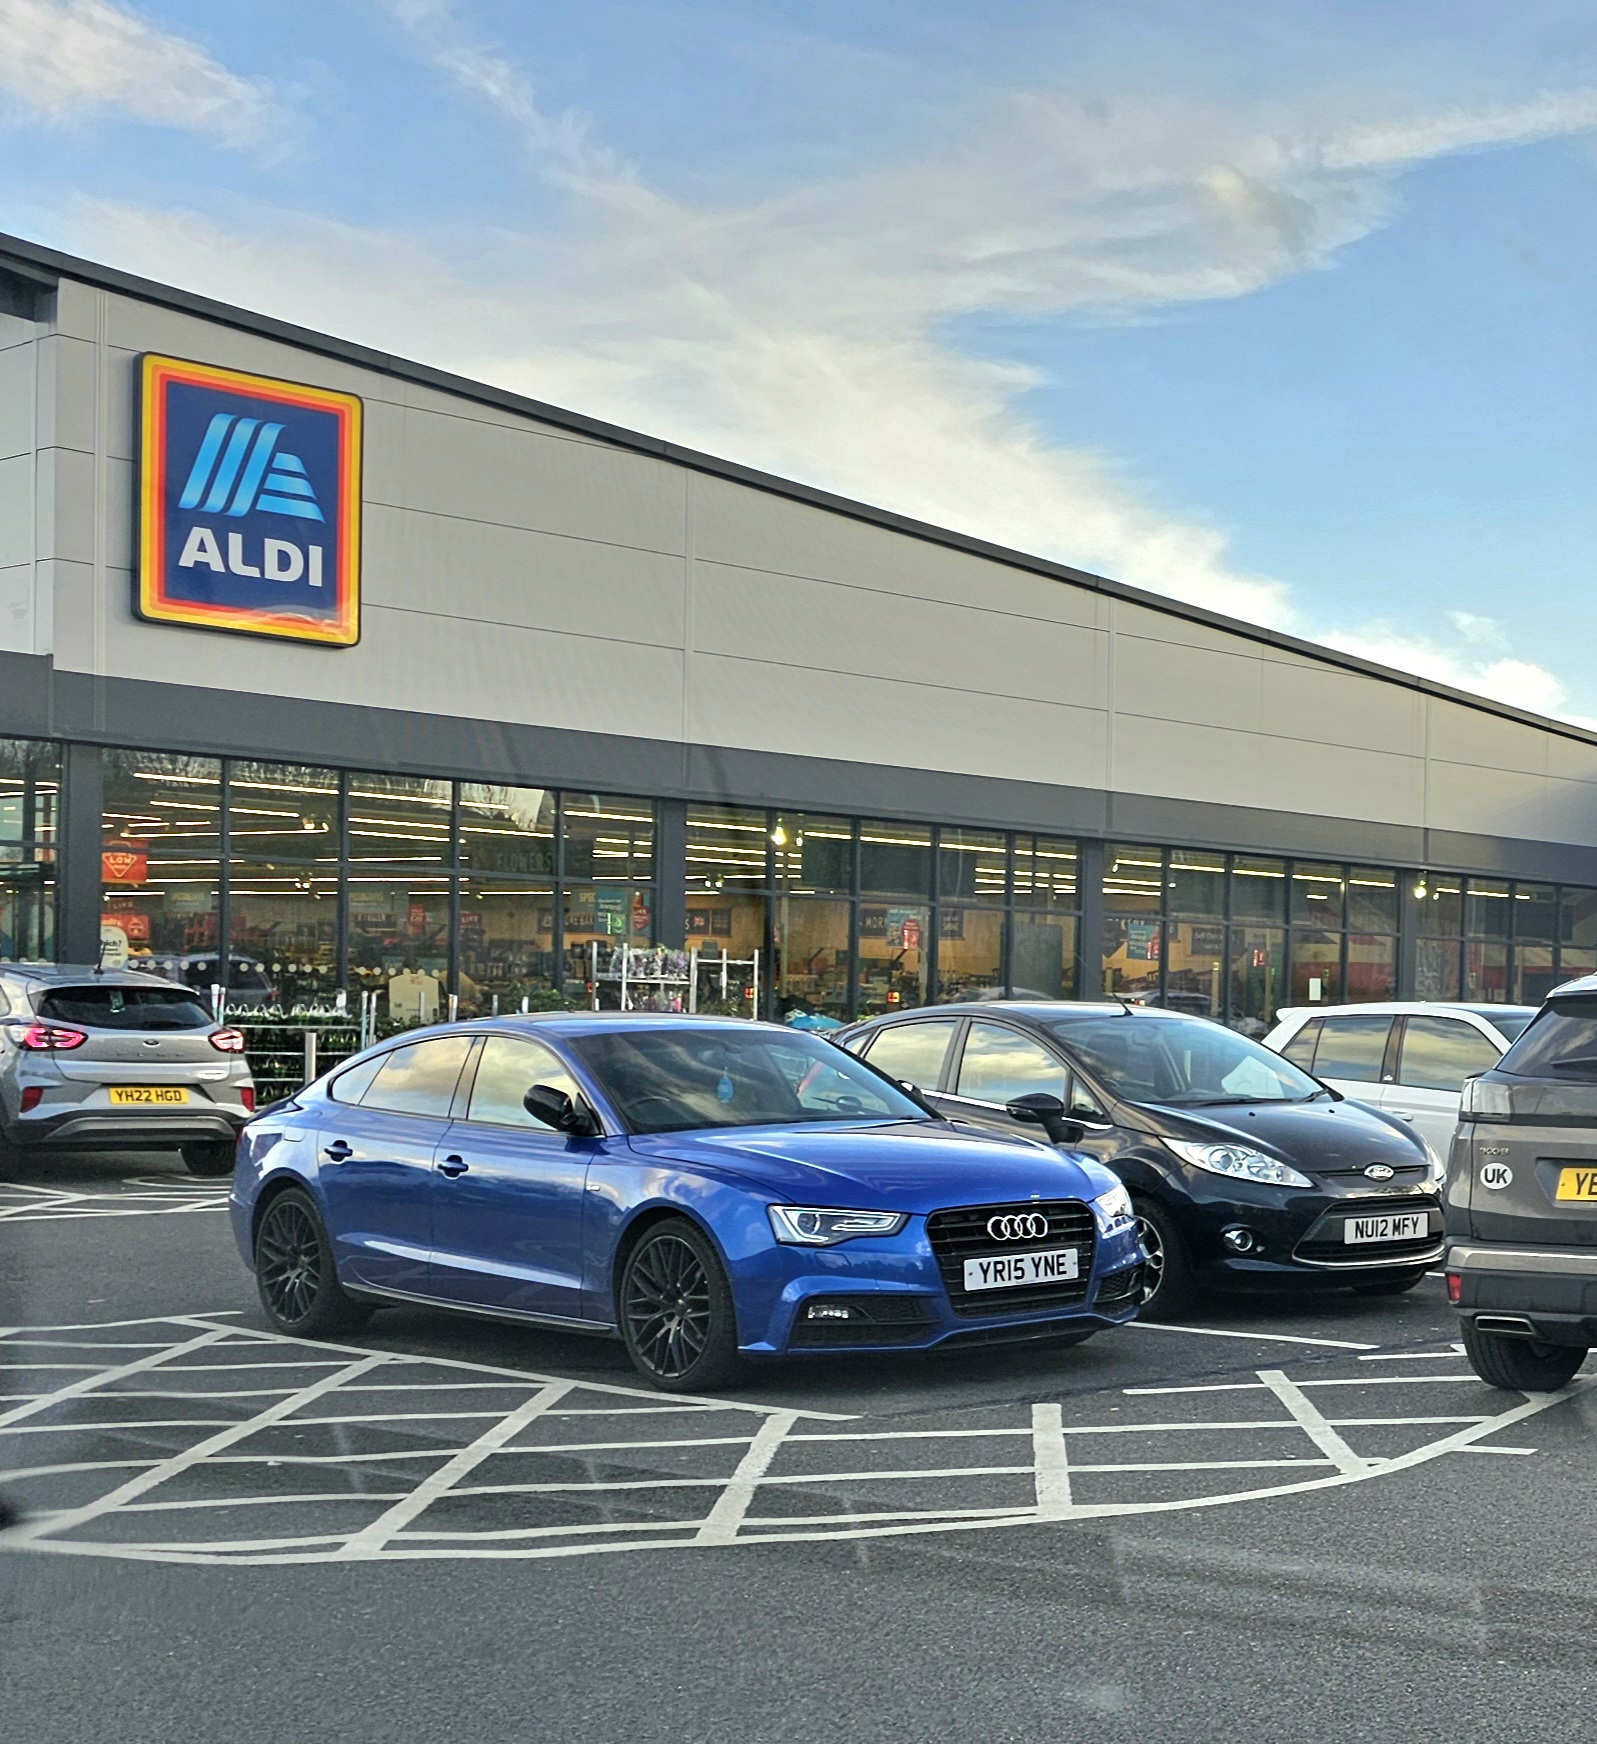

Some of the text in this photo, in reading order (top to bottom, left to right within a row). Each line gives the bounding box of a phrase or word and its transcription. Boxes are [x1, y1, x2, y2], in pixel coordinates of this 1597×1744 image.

[178, 526, 323, 587] ALDI
[108, 855, 132, 864] LOW
[115, 1089, 182, 1102] YH22 HGD
[1484, 1167, 1508, 1185] UK
[1354, 1216, 1420, 1239] NU12 MFY
[978, 1253, 1068, 1284] YR15 YNE
